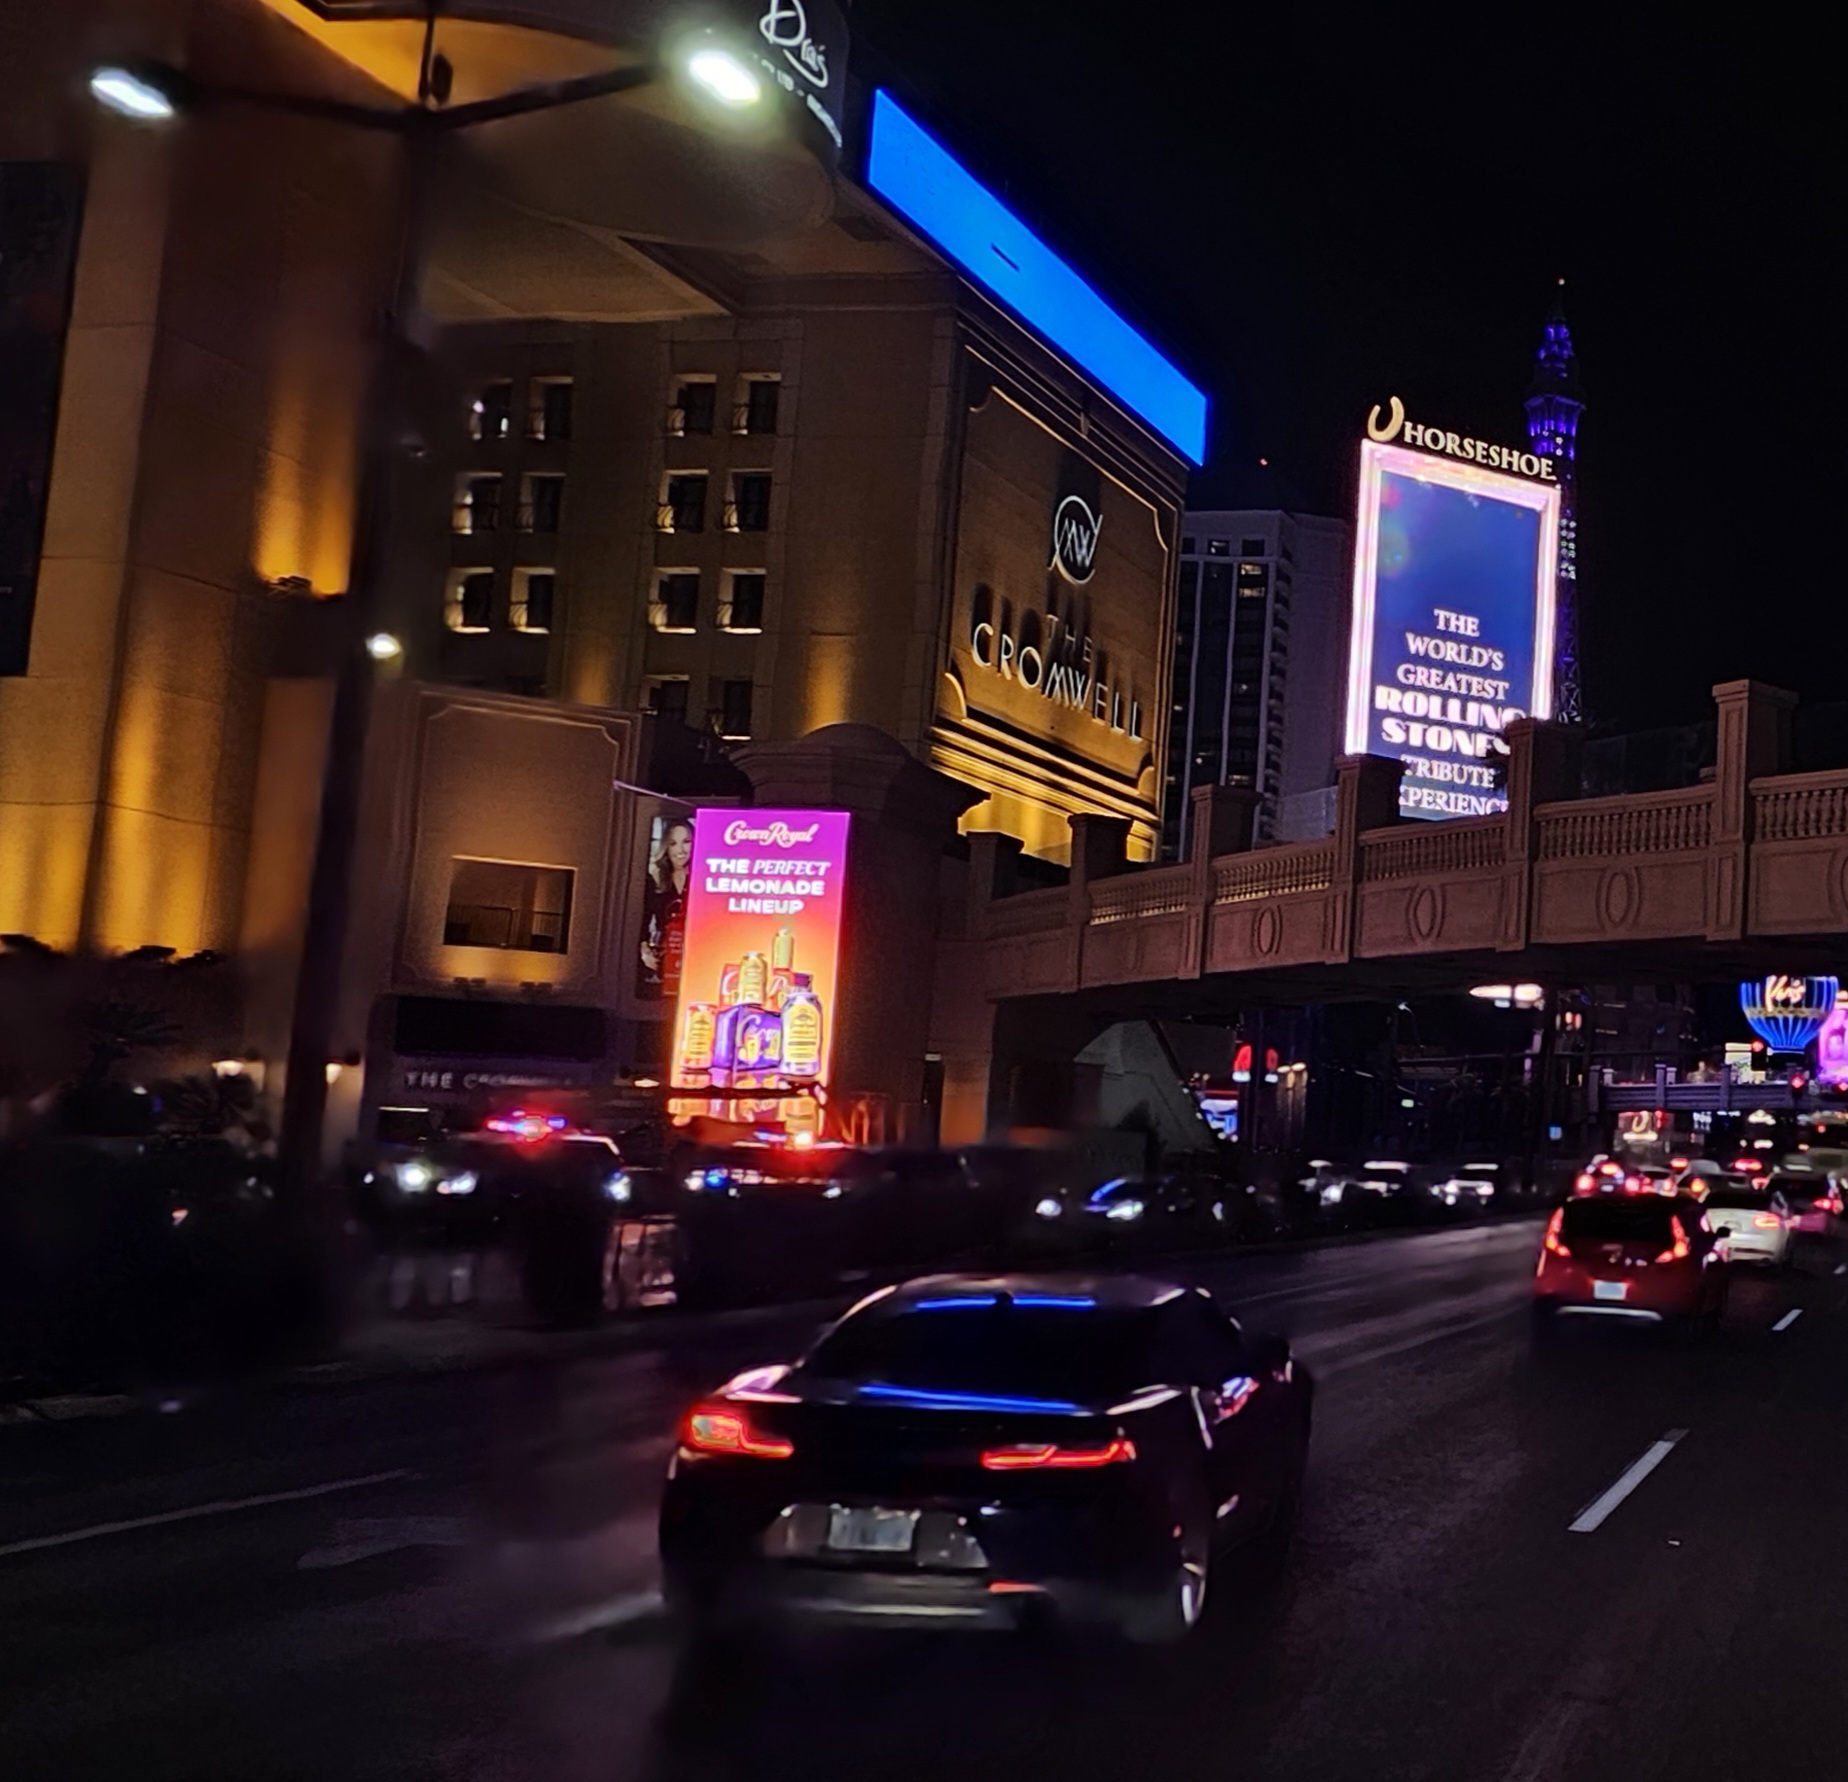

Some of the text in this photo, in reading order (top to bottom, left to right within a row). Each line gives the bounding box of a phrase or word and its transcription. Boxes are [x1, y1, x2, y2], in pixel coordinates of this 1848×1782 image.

[1403, 421, 1558, 480] HORSESHOE
[1047, 613, 1093, 663] THE
[1433, 607, 1480, 638] THE
[1405, 632, 1505, 672] WORLD'S
[972, 622, 1144, 744] CROMWELL
[1396, 662, 1510, 701] GREATEST
[1400, 753, 1496, 789] TRIBUTE
[1398, 784, 1509, 816] PERIENC
[724, 820, 820, 848] Crown Royal
[705, 858, 831, 877] THE PERFECT
[705, 877, 825, 896] LEMONADE
[728, 898, 805, 915] LINEUP
[405, 1071, 454, 1090] THE
